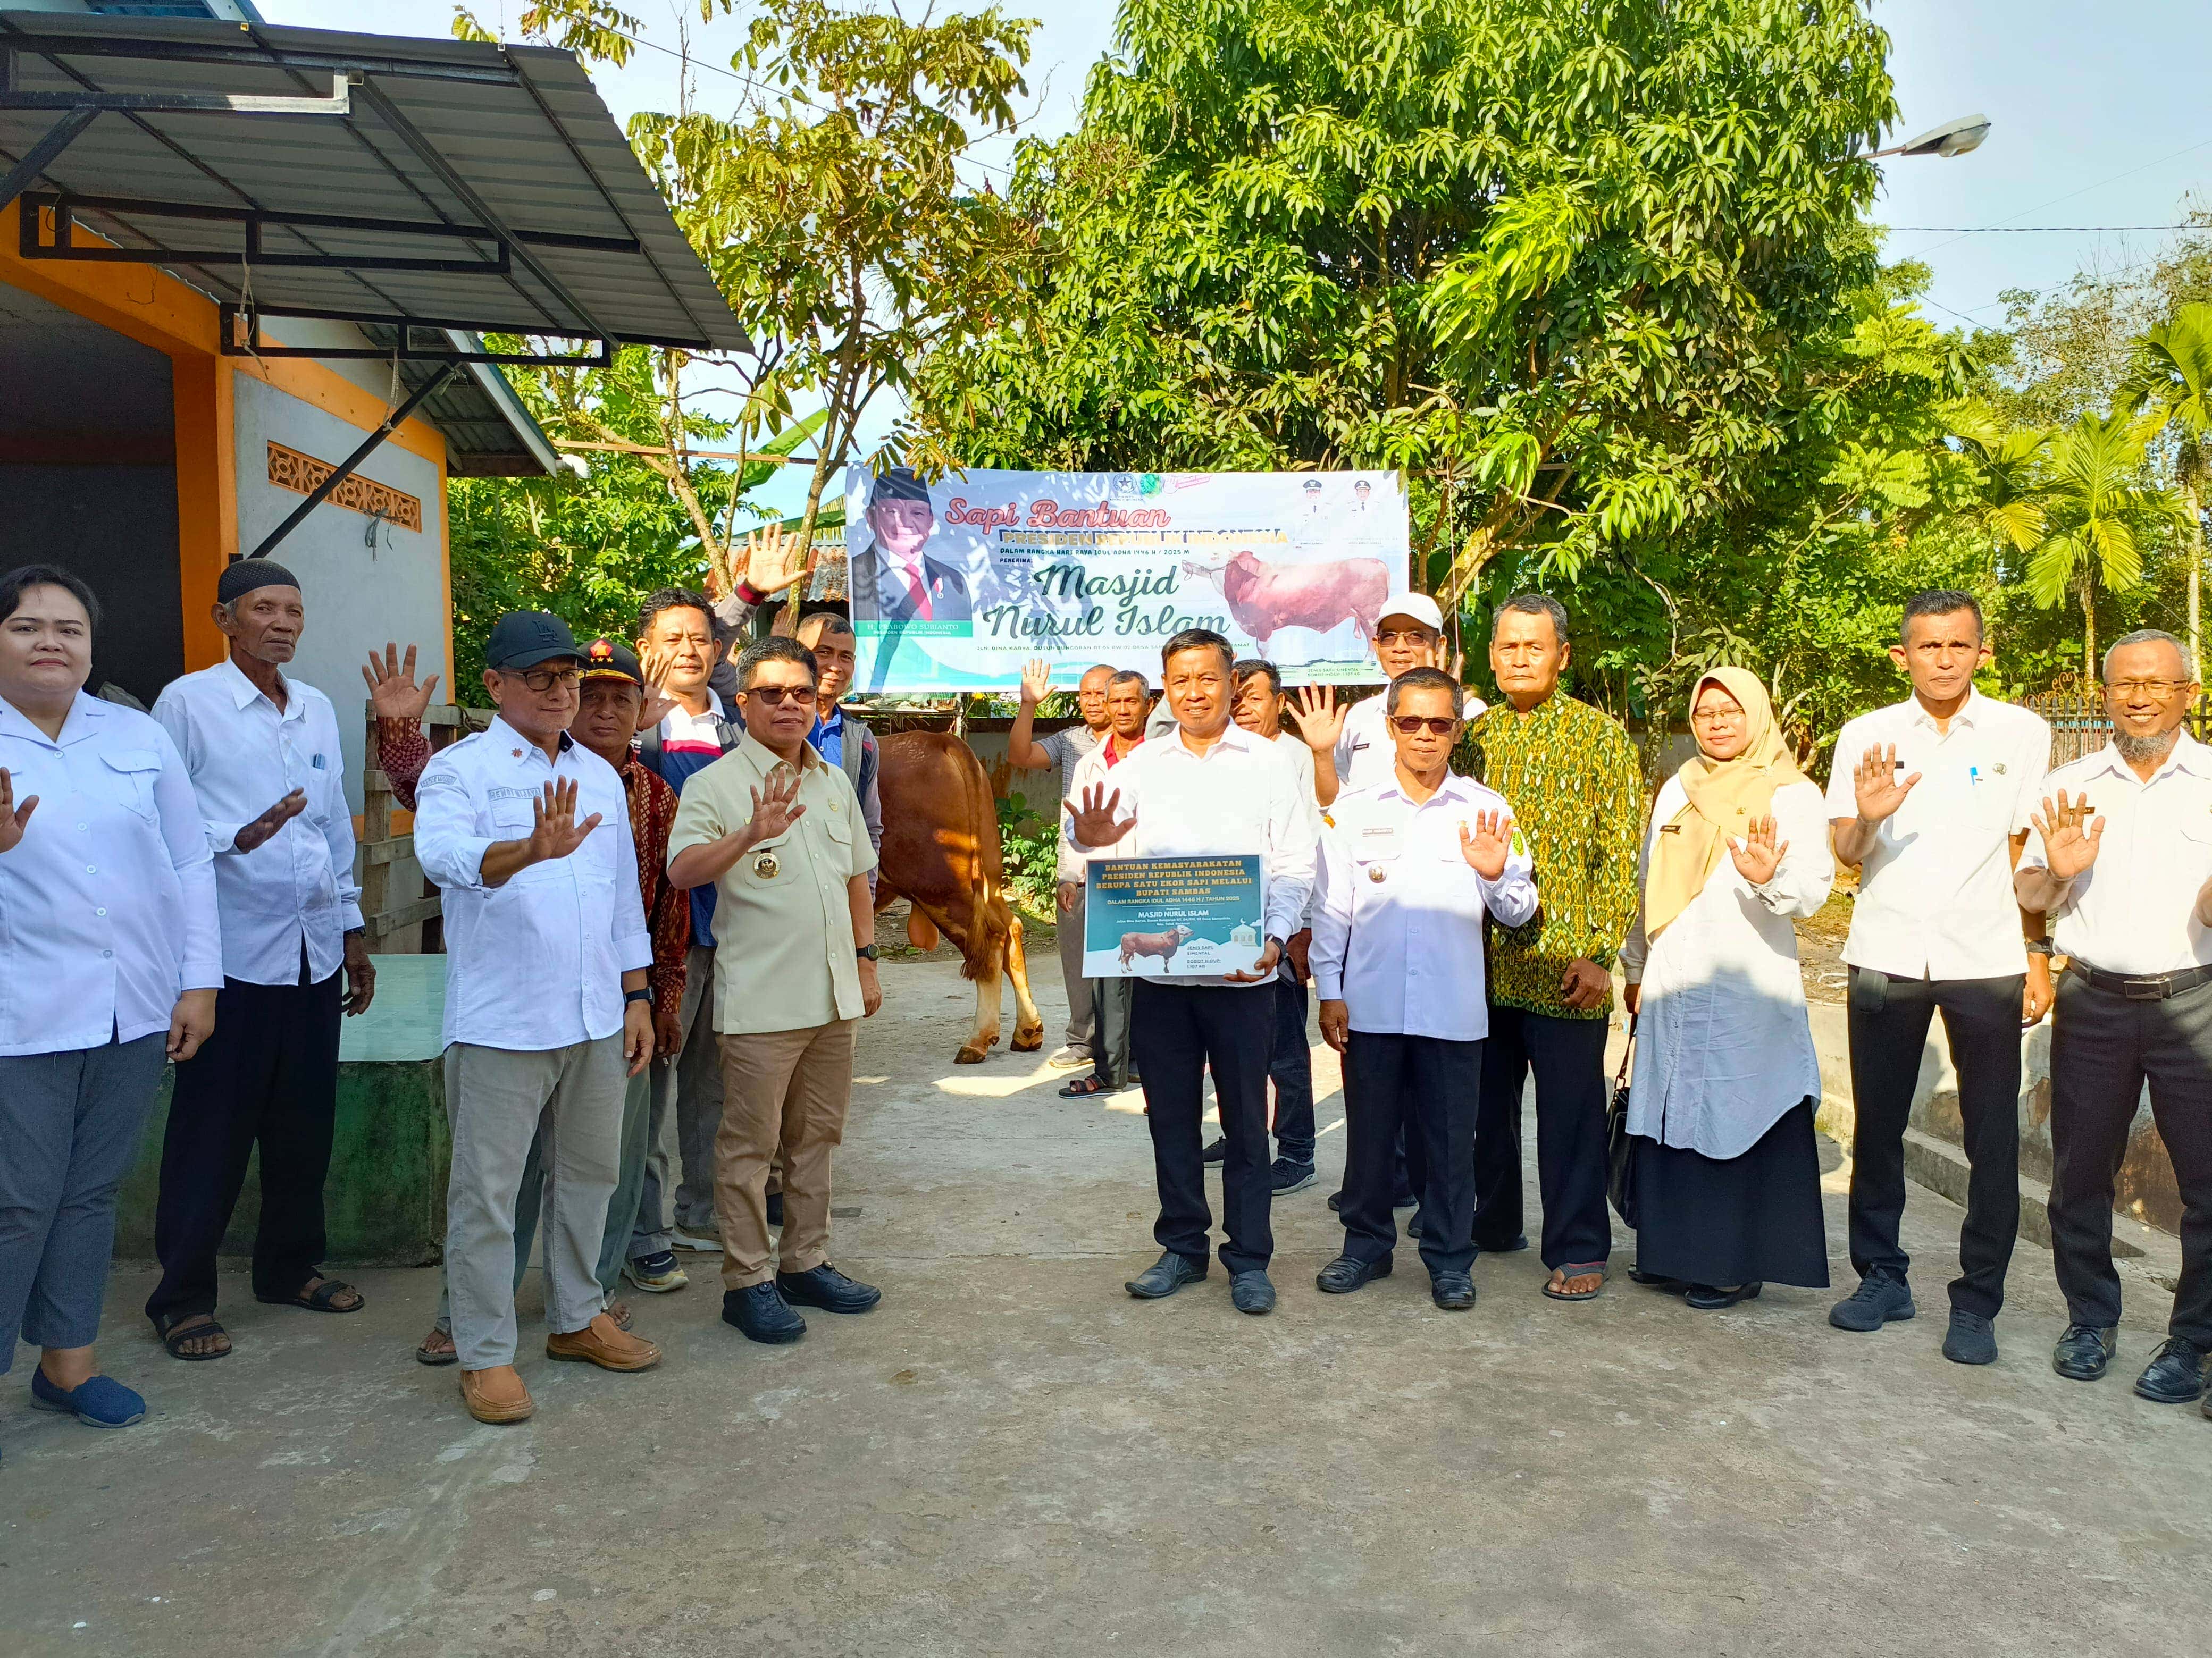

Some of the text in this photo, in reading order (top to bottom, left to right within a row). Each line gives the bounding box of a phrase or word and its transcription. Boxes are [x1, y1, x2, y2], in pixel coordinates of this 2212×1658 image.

[945, 498, 1171, 535] Sapi Bantuan
[1000, 530, 1092, 545] PRESIDEN
[1034, 564, 1179, 607] Masjid
[983, 605, 1230, 639] Nurul Islam
[1151, 860, 1242, 870] KEMASYARAKATAN
